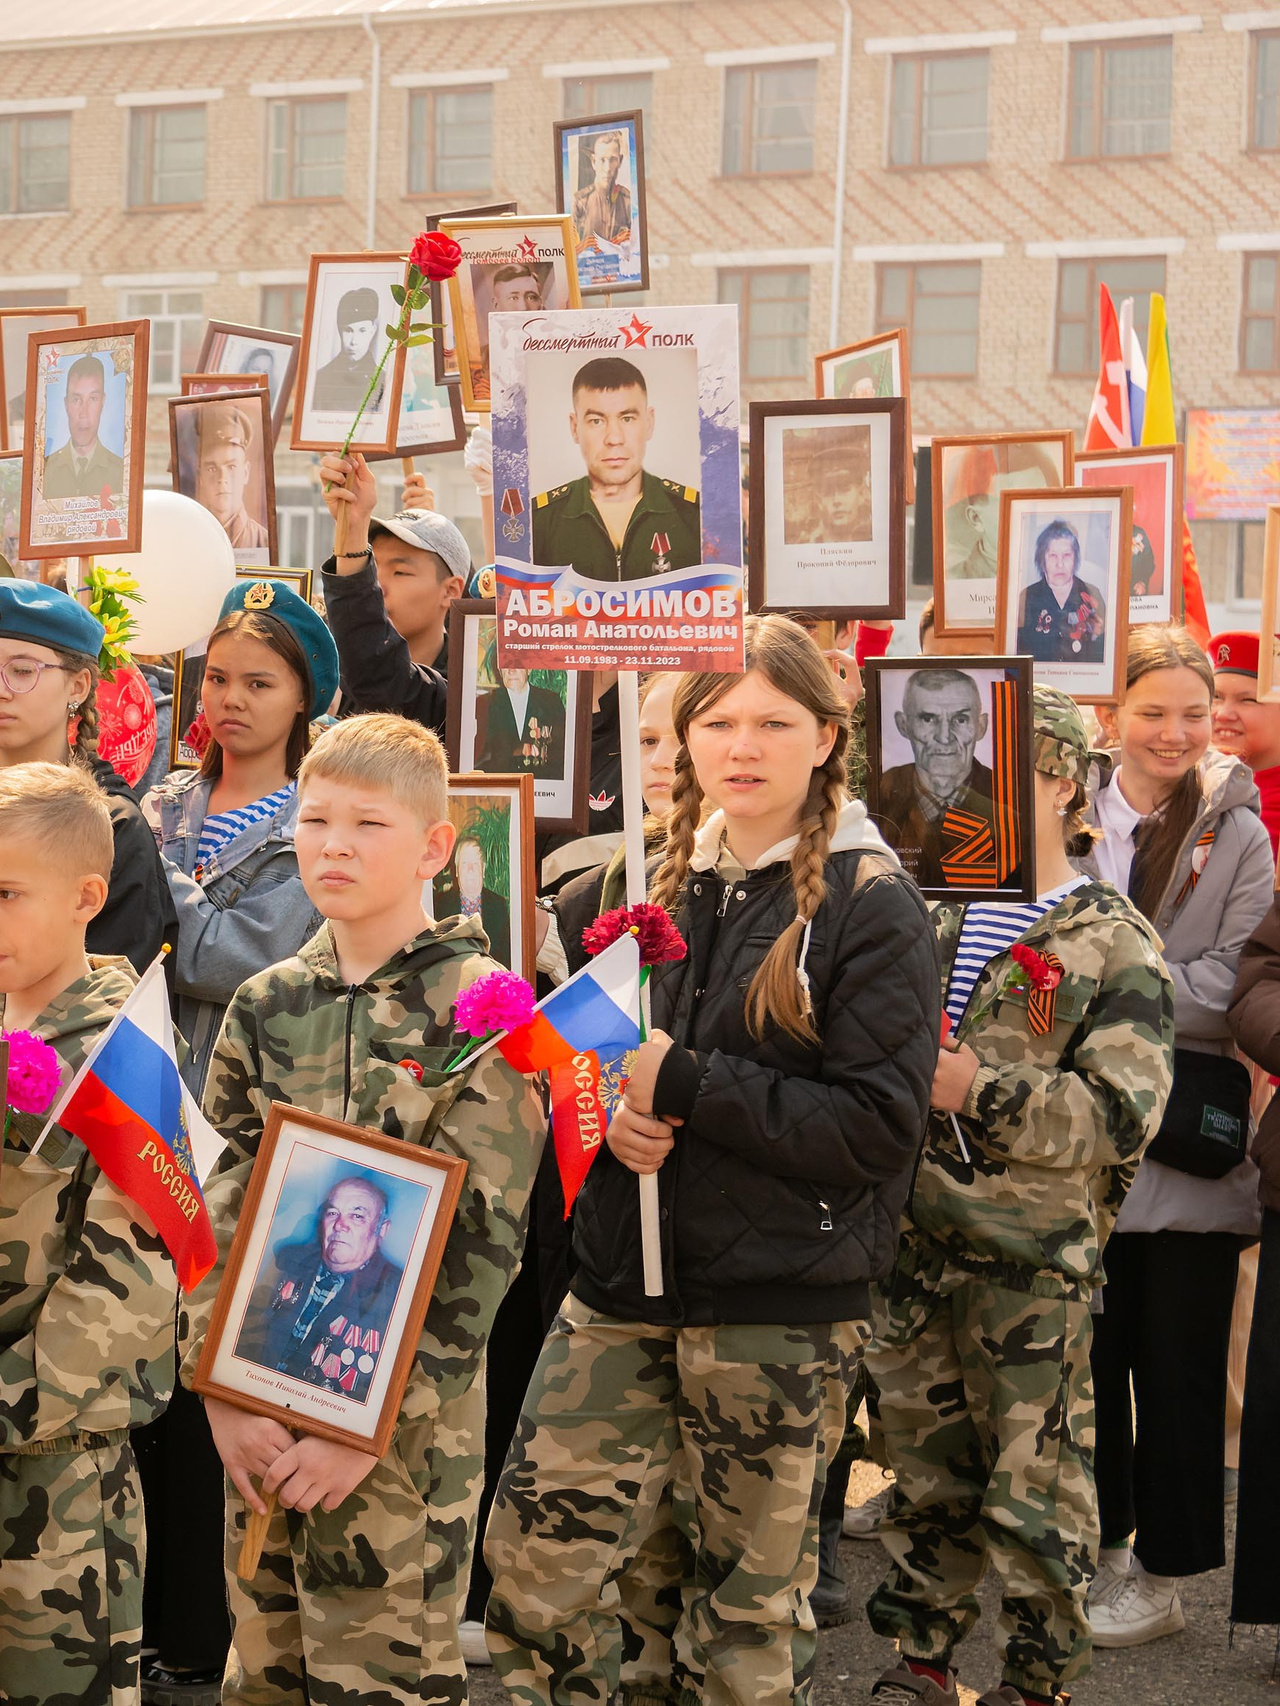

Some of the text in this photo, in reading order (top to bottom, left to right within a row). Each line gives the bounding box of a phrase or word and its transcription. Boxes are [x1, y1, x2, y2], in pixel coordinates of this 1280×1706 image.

[459, 243, 518, 259] ессмертный
[522, 317, 694, 353] бессмертный ПОЛК
[65, 500, 99, 509] Михайлов
[39, 509, 127, 523] Владимир Александрович
[506, 589, 737, 618] АБРОСИМОВ
[503, 620, 738, 639] Роман Анатольевич
[505, 642, 735, 653] старший стрелок мотострелкового батальона, рядовой
[564, 655, 618, 664] 11.09.1983
[625, 656, 681, 665] 23.11.2023
[571, 1051, 601, 1152] ОССИЯ
[136, 1140, 201, 1224] РОССИЯ
[245, 1370, 347, 1413] Тихонов Николай Андреевич
